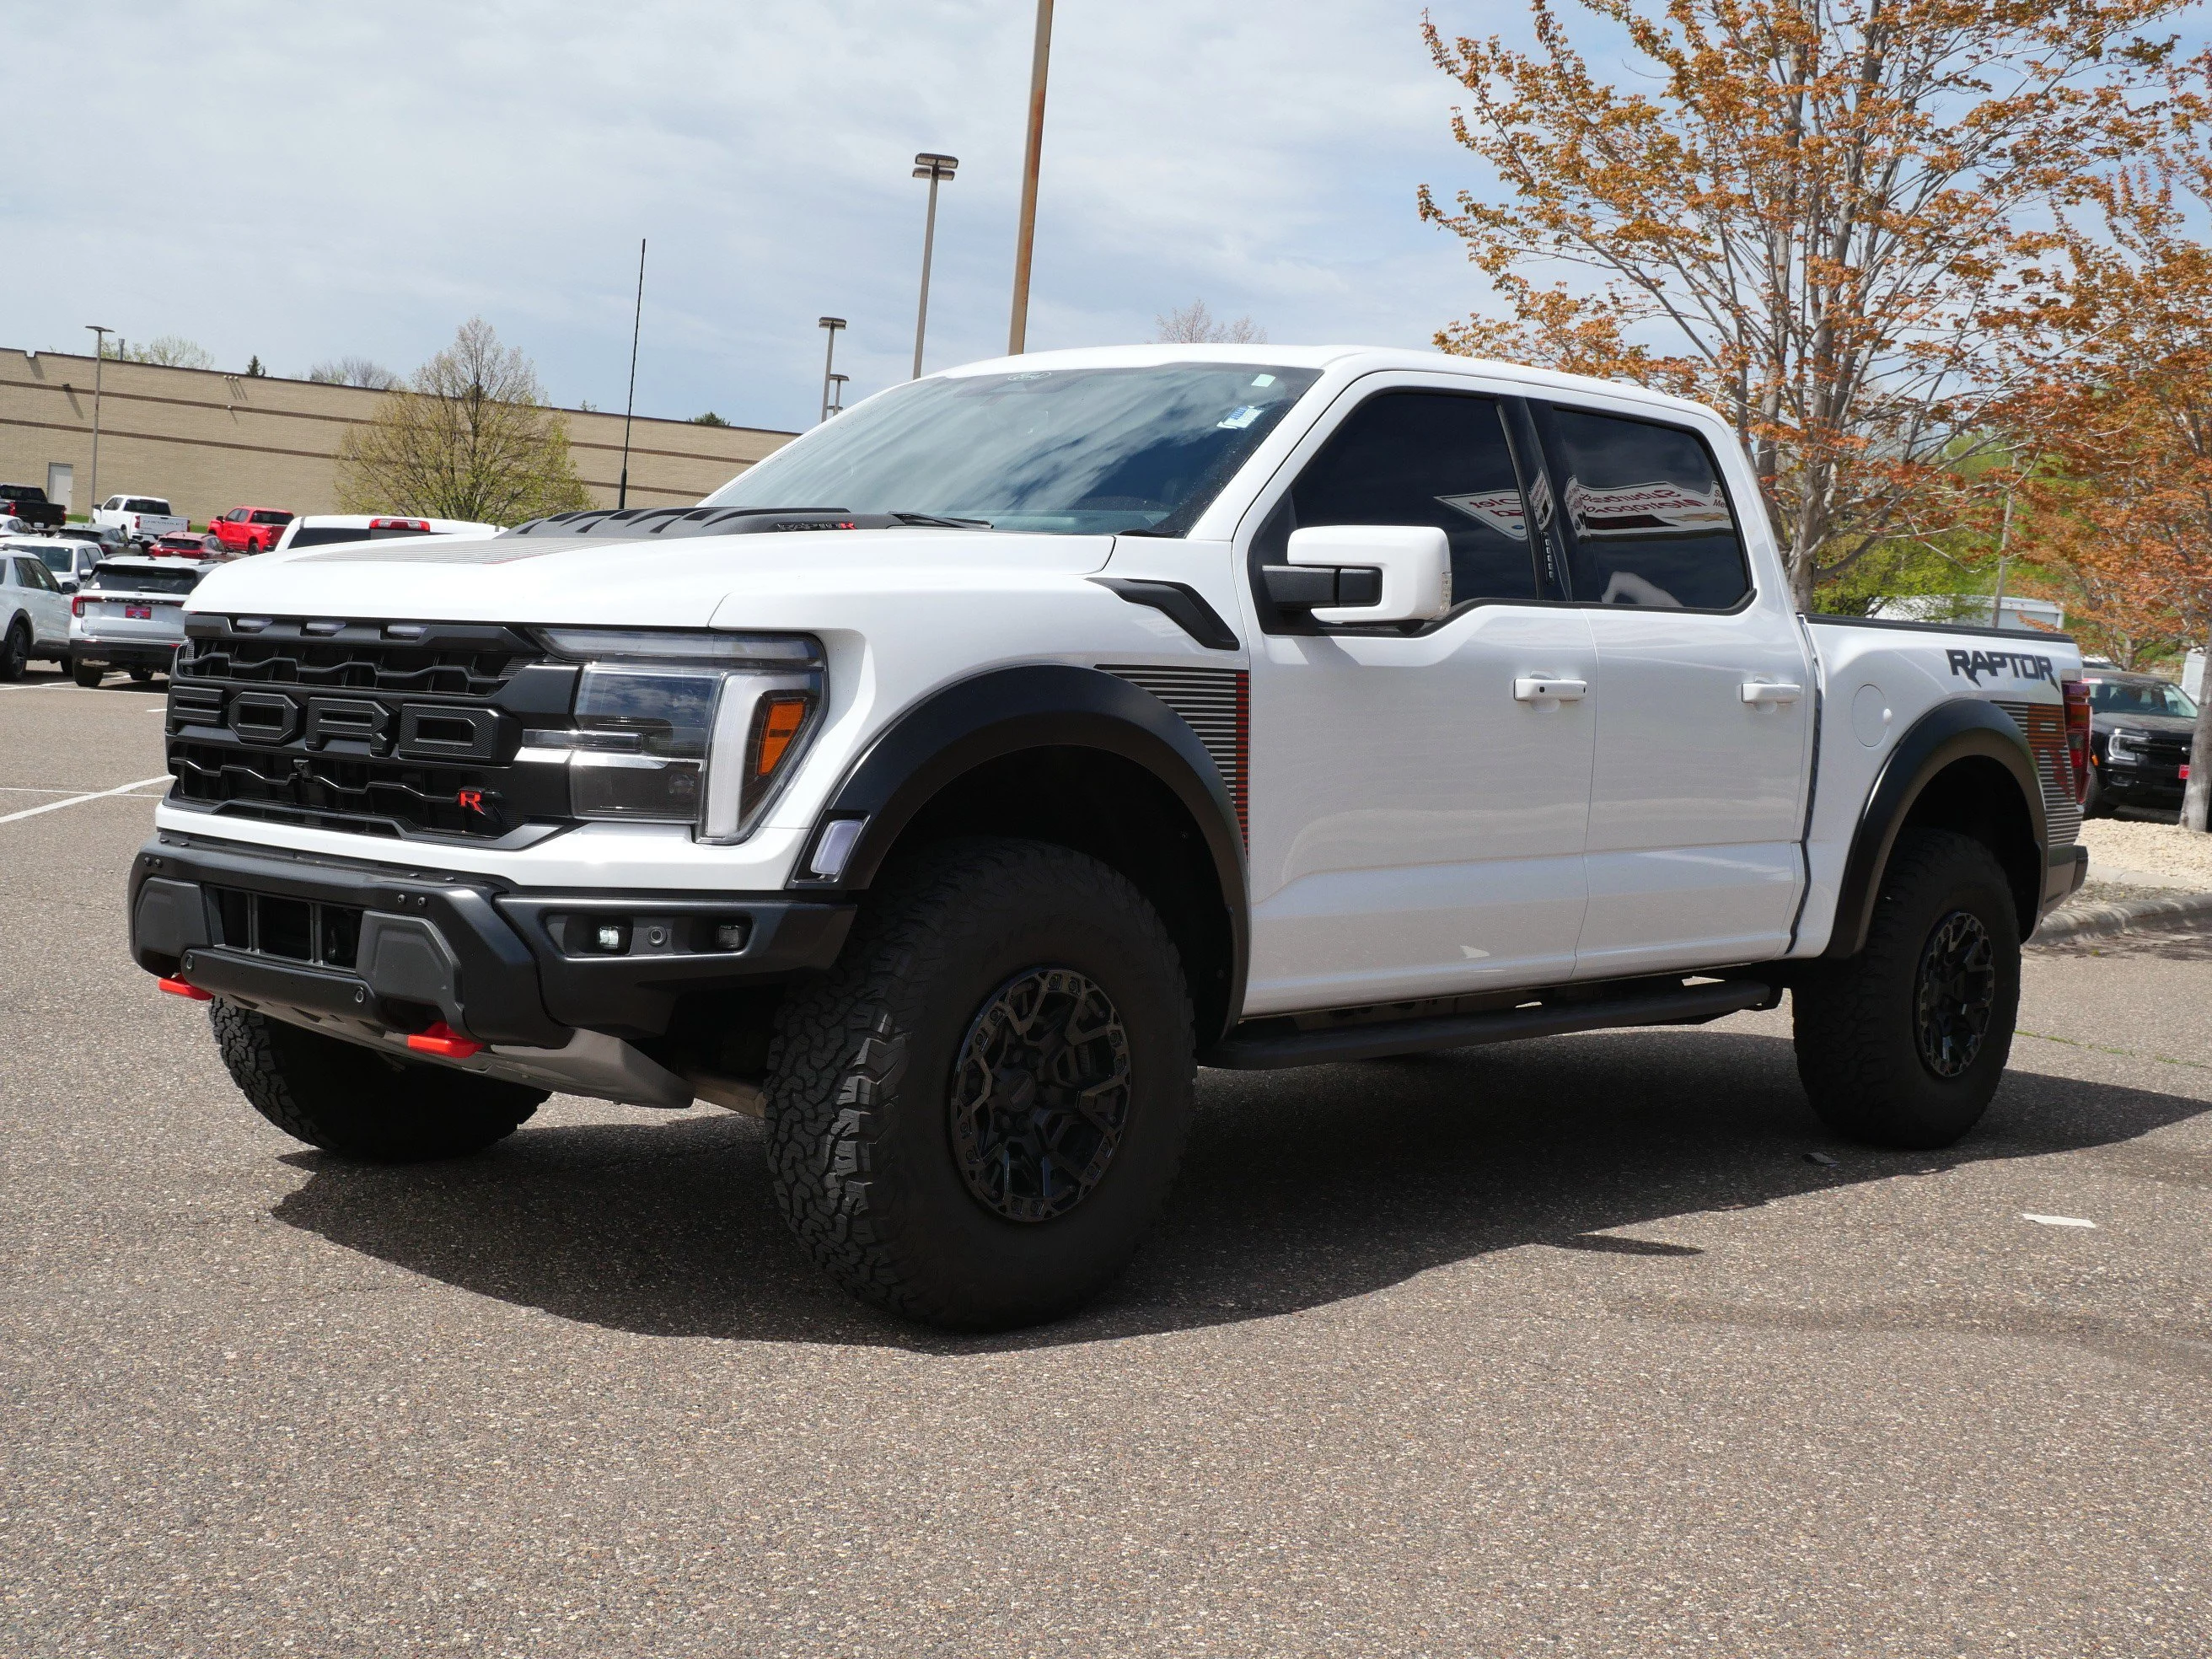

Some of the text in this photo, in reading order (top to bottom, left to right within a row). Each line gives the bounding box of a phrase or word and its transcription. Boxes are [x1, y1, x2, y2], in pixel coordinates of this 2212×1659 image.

[1945, 648, 2060, 694] RAPTOR
[165, 685, 499, 762] FORD
[459, 789, 486, 816] R
